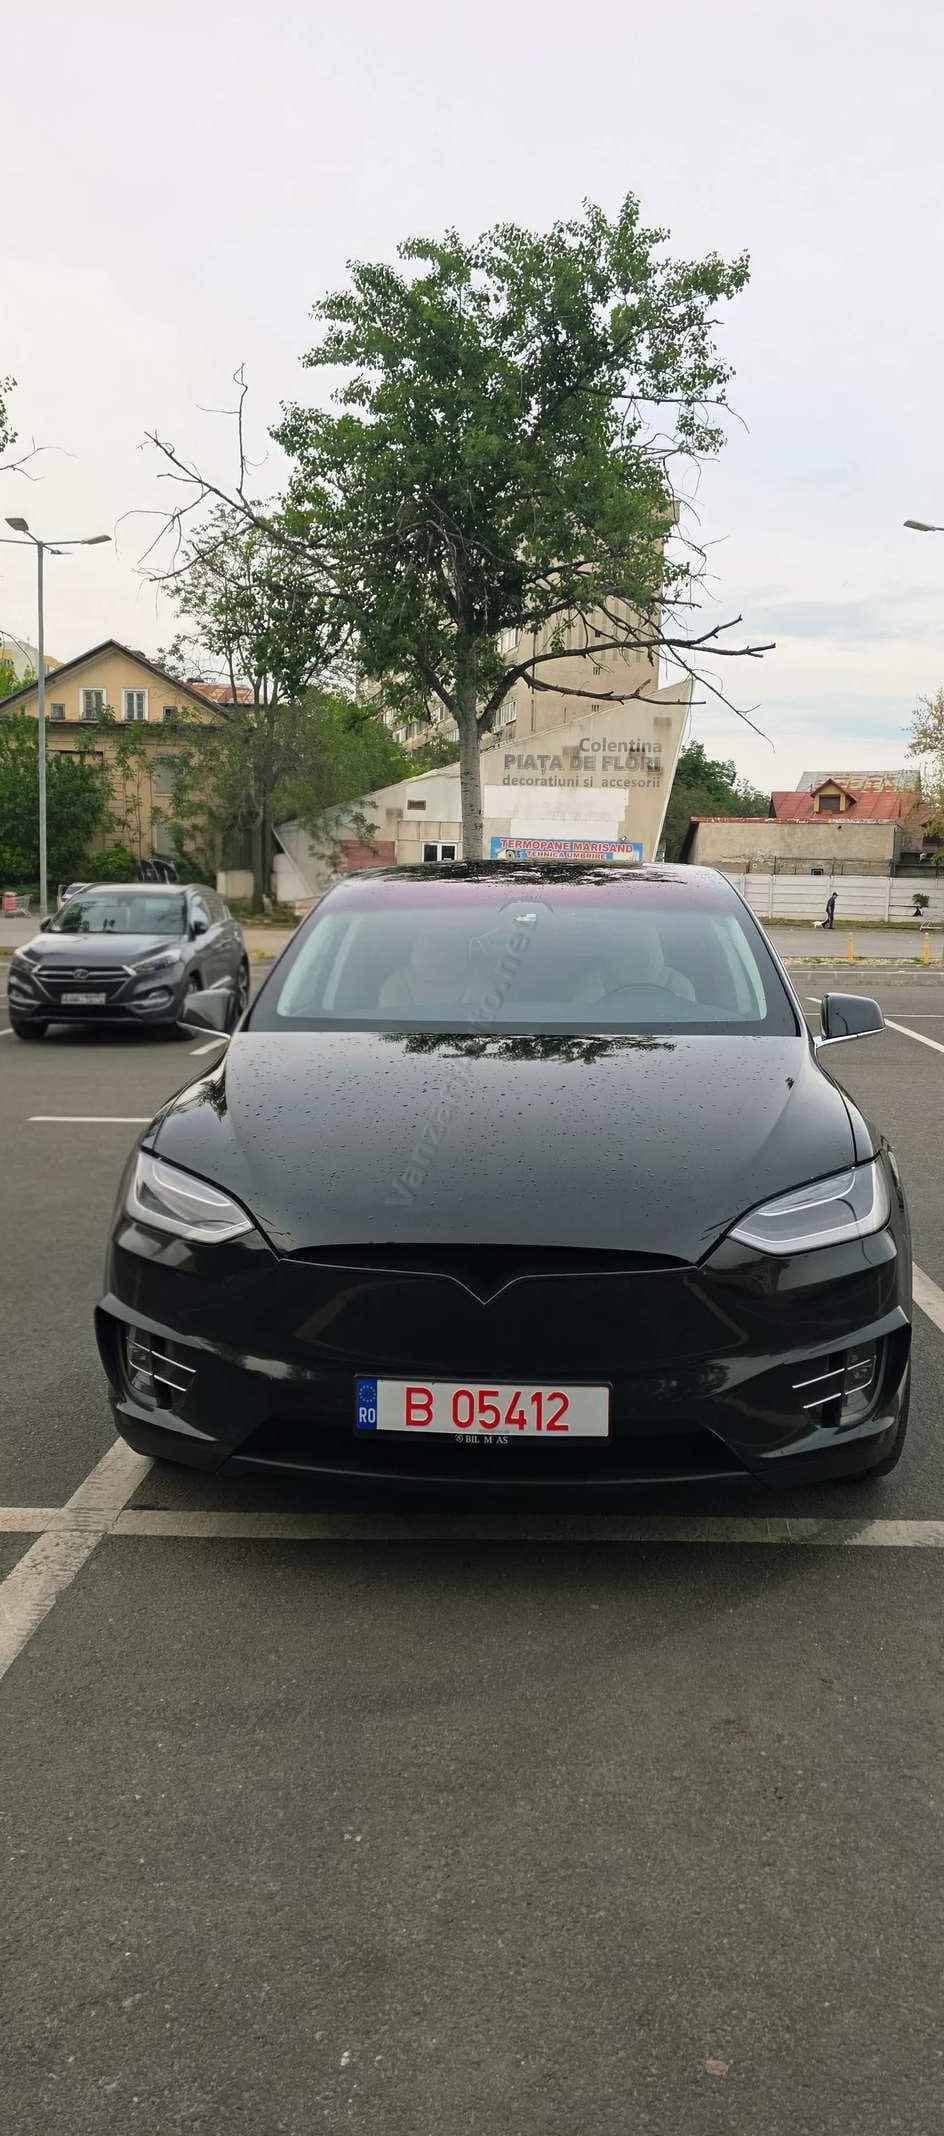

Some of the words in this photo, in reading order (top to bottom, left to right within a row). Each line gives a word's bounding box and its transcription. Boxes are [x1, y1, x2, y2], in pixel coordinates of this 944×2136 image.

[579, 737, 662, 753] Colentina
[570, 755, 596, 771] DE
[602, 755, 662, 772] FLORI
[601, 777, 660, 788] accesorii
[501, 839, 570, 850] TERMOPANE
[573, 842, 633, 853] MARISAND
[359, 1407, 376, 1424] RO
[405, 1387, 434, 1426] B
[452, 1389, 570, 1431] 05412
